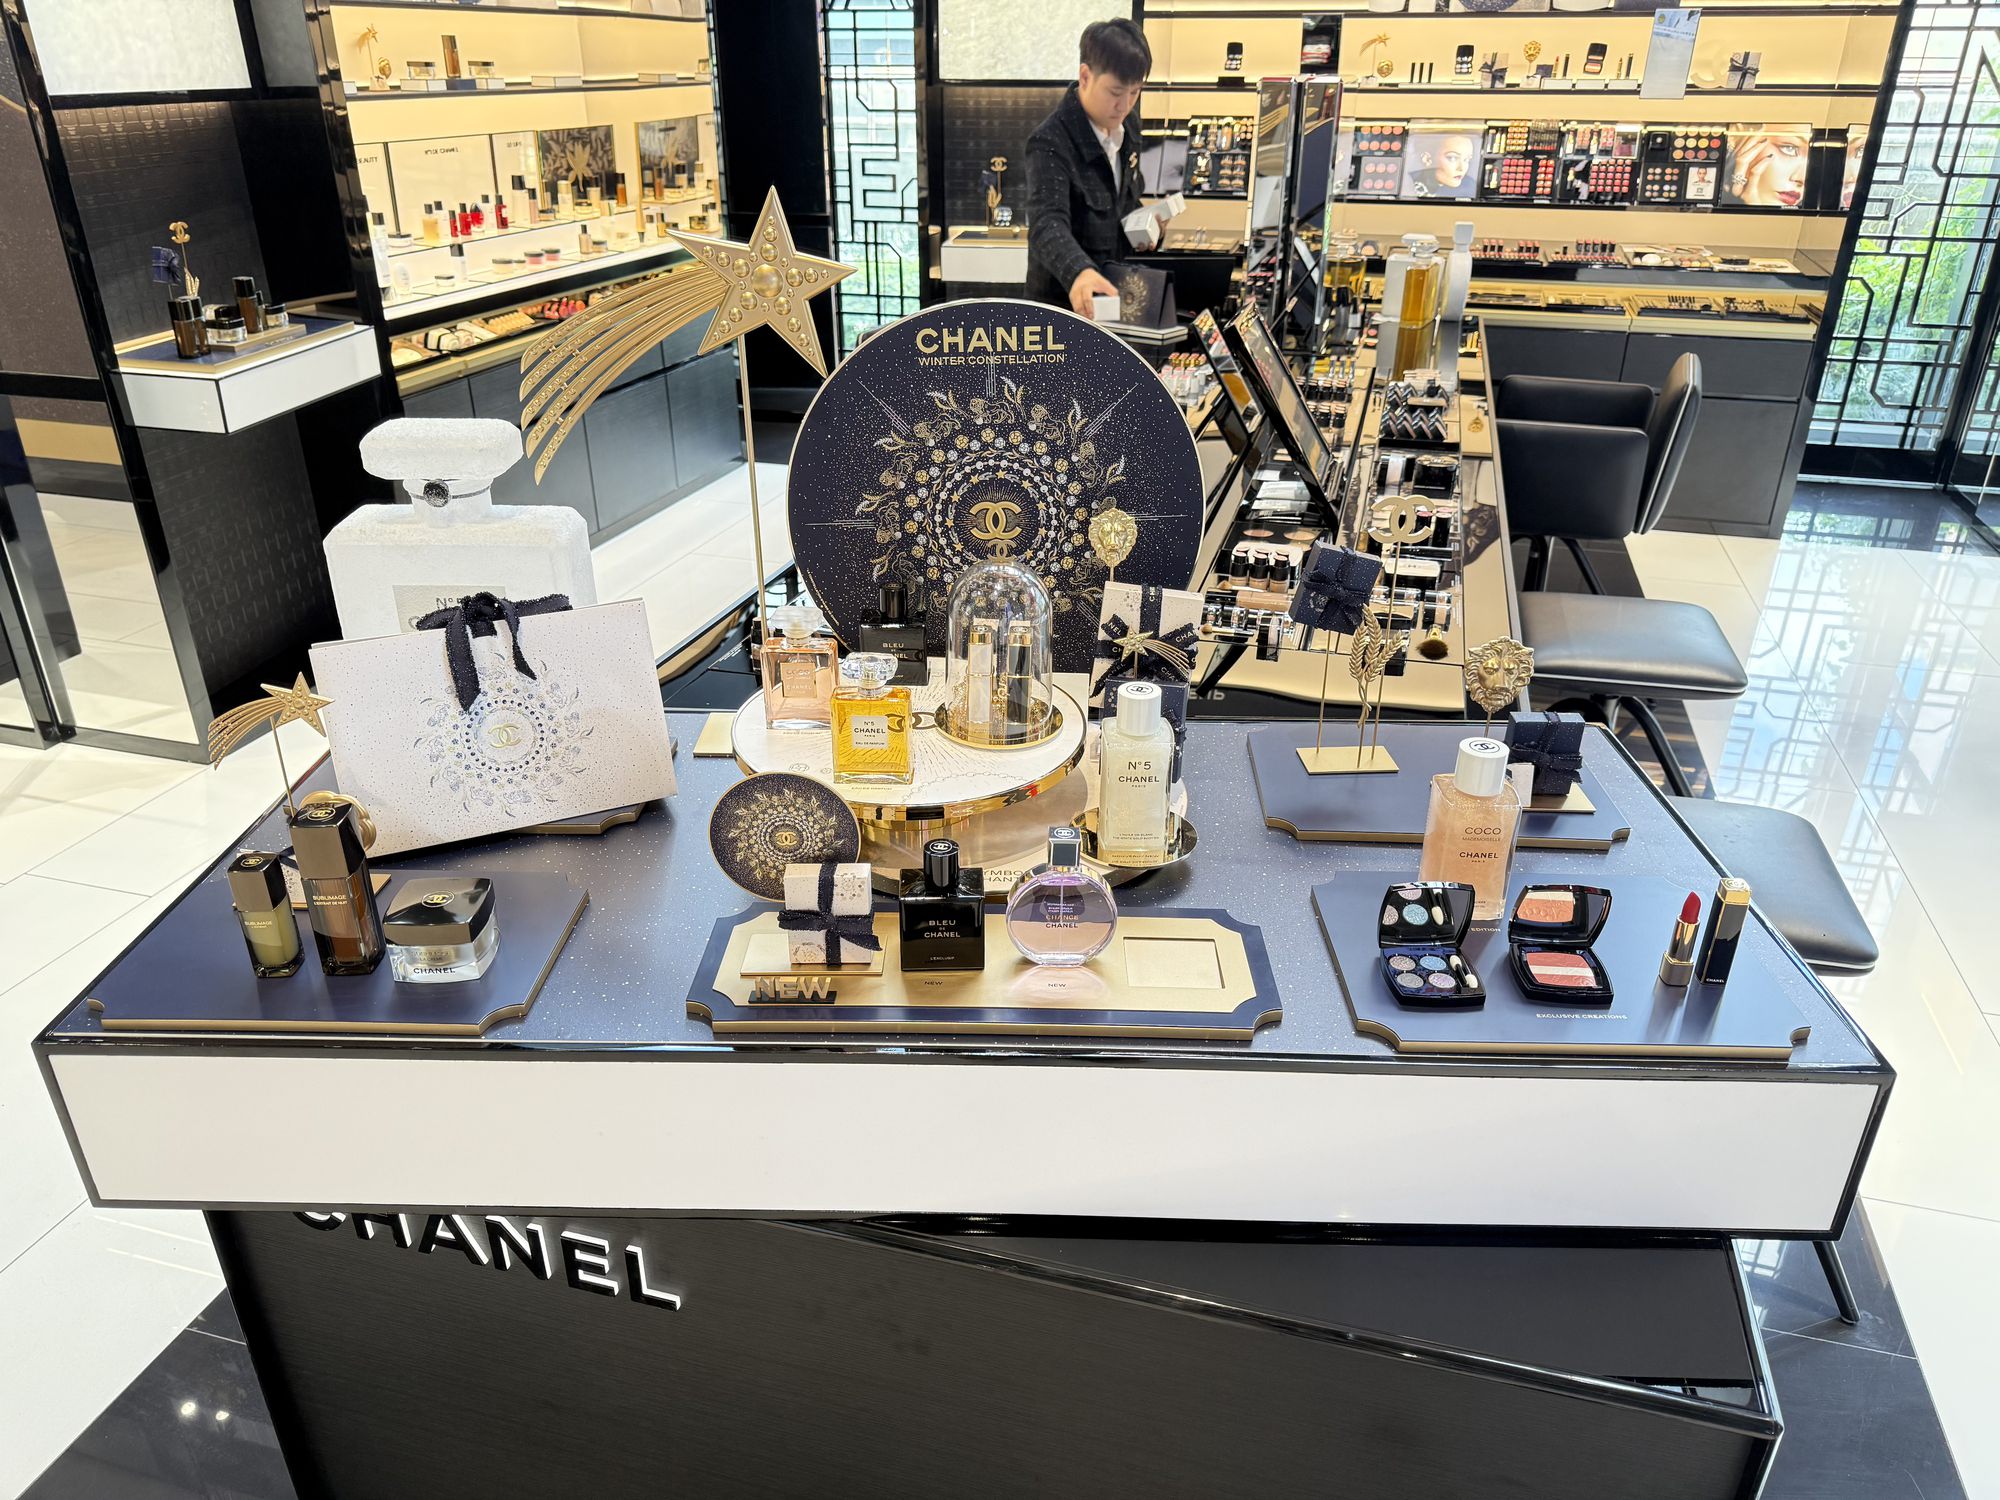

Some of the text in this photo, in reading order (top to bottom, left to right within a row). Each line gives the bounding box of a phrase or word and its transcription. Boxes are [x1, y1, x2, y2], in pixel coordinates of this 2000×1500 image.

[916, 325, 1065, 354] CHANEL
[918, 353, 1066, 366] WINTER CONSTELLATION
[1118, 775, 1160, 783] CHANEL
[1464, 826, 1502, 836] COCO
[1459, 851, 1499, 859] CHANEL
[754, 976, 832, 1000] NEW
